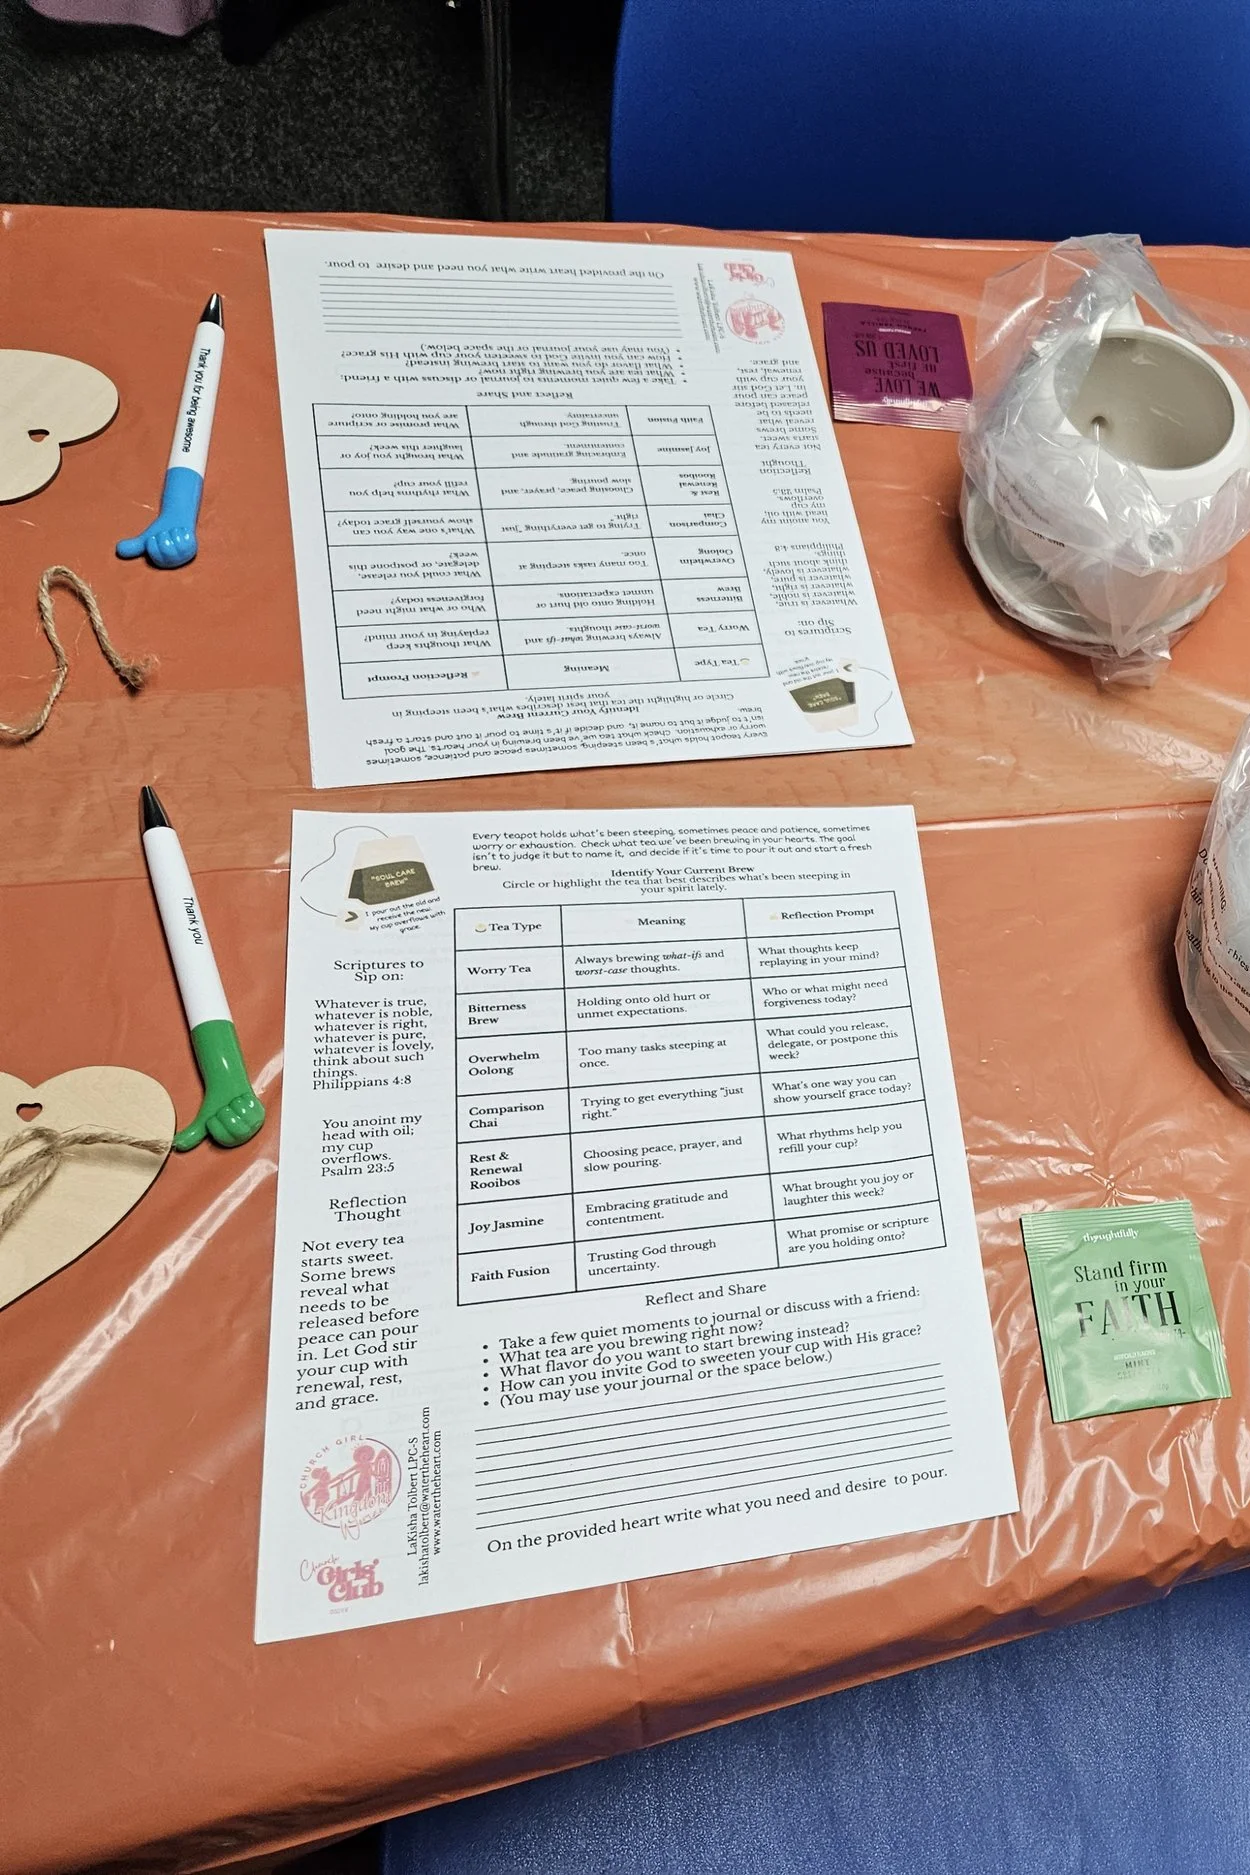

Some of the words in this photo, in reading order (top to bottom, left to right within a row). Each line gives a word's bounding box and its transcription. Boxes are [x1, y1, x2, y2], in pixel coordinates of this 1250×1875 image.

[854, 340, 877, 357] US
[884, 342, 939, 363] LOVED
[199, 348, 210, 368] Thank
[887, 360, 916, 371] first
[922, 363, 936, 373] HE
[194, 370, 203, 384] you
[865, 368, 915, 380] because
[193, 385, 204, 395] for
[874, 377, 911, 396] LOVE
[916, 380, 940, 397] WE
[476, 391, 509, 399] Share
[510, 391, 532, 399] and
[535, 391, 574, 400] Reflect
[187, 396, 202, 416] being
[182, 417, 195, 453] awesome
[784, 629, 796, 637] to
[797, 625, 852, 635] Scriptures
[563, 664, 610, 672] Meaning
[694, 658, 721, 667] Type
[720, 658, 740, 666] Tea
[367, 674, 410, 683] Prompt
[412, 671, 468, 680] Reflection
[496, 712, 525, 720] Brew
[526, 710, 570, 718] Current
[598, 705, 639, 714] Identify
[472, 832, 502, 841] Every
[502, 831, 538, 841] teapot
[539, 829, 567, 839] holds
[569, 828, 605, 838] what's
[606, 828, 631, 838] been
[632, 828, 676, 838] steeping,
[677, 827, 730, 835] sometimes
[730, 827, 759, 835] peace
[759, 825, 778, 834] and
[779, 826, 821, 835] patience,
[822, 824, 871, 833] sometimes
[396, 868, 415, 877] CARE
[610, 868, 655, 877] Identify
[655, 867, 682, 876] Your
[683, 866, 726, 875] Current
[727, 865, 755, 873] Brew
[182, 897, 199, 925] Thank
[780, 910, 834, 920] Reflection
[835, 908, 874, 917] Prompt
[488, 922, 510, 932] Tea
[511, 921, 542, 933] Type
[637, 916, 686, 926] Meaning
[188, 928, 203, 945] you
[333, 959, 406, 973] Scriptures
[410, 960, 424, 968] to
[466, 966, 507, 976] Worry
[508, 964, 532, 973] Tea
[354, 971, 378, 984] Sip
[381, 972, 404, 981] on:
[314, 998, 381, 1009] Whatever
[383, 997, 394, 1008] is
[396, 998, 427, 1007] true,
[468, 1003, 527, 1013] Bitterness
[467, 1016, 499, 1026] Brew
[467, 1050, 540, 1064] Overwhelm
[468, 1065, 514, 1076] Oolong
[312, 1076, 389, 1091] Philippians
[392, 1074, 412, 1085] 4:8
[468, 1102, 545, 1116] Comparison
[468, 1117, 498, 1129] Chai
[321, 1164, 363, 1177] Psalm
[366, 1161, 395, 1174] 23:5
[468, 1220, 490, 1235] Joy
[491, 1216, 544, 1231] Jasmine
[1083, 1228, 1139, 1243] thoughtfully
[470, 1269, 504, 1283] Faith
[507, 1265, 550, 1278] Fusion
[1074, 1262, 1124, 1282] Stand
[1129, 1260, 1167, 1276] firm
[1115, 1280, 1128, 1292] in
[1133, 1277, 1166, 1293] your
[644, 1291, 694, 1307] Reflect
[697, 1284, 724, 1300] and
[727, 1283, 767, 1296] Share
[1074, 1290, 1182, 1338] FAITH
[300, 1445, 330, 1489] CHURCH
[336, 1435, 364, 1445] GIRL
[408, 1436, 418, 1474] LPC-S
[407, 1474, 418, 1513] Tolbert
[418, 1406, 430, 1586] lakishatolbert@watertheheart.com
[431, 1430, 442, 1555] www.watertheheart.com
[486, 1538, 512, 1553] On
[516, 1533, 542, 1549] the
[546, 1519, 617, 1548] provided
[620, 1515, 660, 1532] heart
[663, 1507, 702, 1523] write
[705, 1502, 741, 1516] what
[743, 1497, 772, 1514] you
[775, 1487, 811, 1506] need
[814, 1482, 841, 1499] and
[844, 1477, 887, 1494] desire
[893, 1474, 908, 1485] to
[910, 1468, 948, 1486] pour.
[407, 1514, 418, 1556] LaKisha
[328, 1577, 384, 1602] Club
